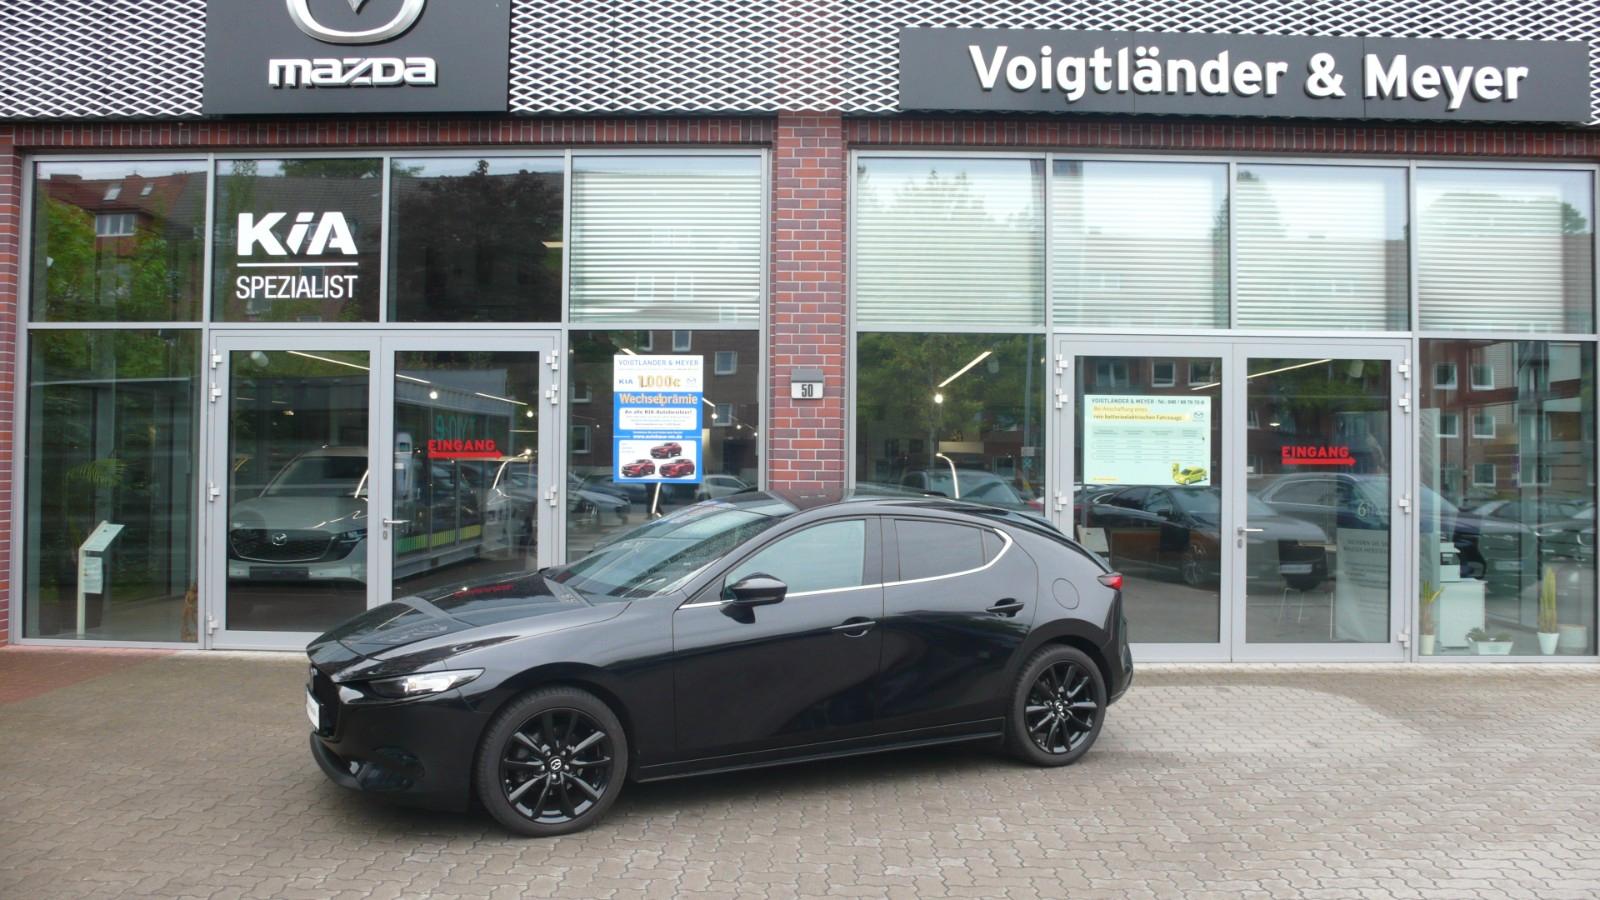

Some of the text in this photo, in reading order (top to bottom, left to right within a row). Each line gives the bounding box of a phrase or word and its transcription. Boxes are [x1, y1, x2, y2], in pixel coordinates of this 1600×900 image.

[268, 56, 437, 88] mazda
[968, 44, 1529, 111] Voigtländer & Meyer
[237, 211, 358, 256] KIA
[236, 274, 359, 299] SPEZIALIST
[619, 392, 698, 406] Wechselprämie
[801, 383, 814, 398] 50
[428, 439, 496, 451] EINGANG
[1281, 445, 1349, 458] EINGANG
